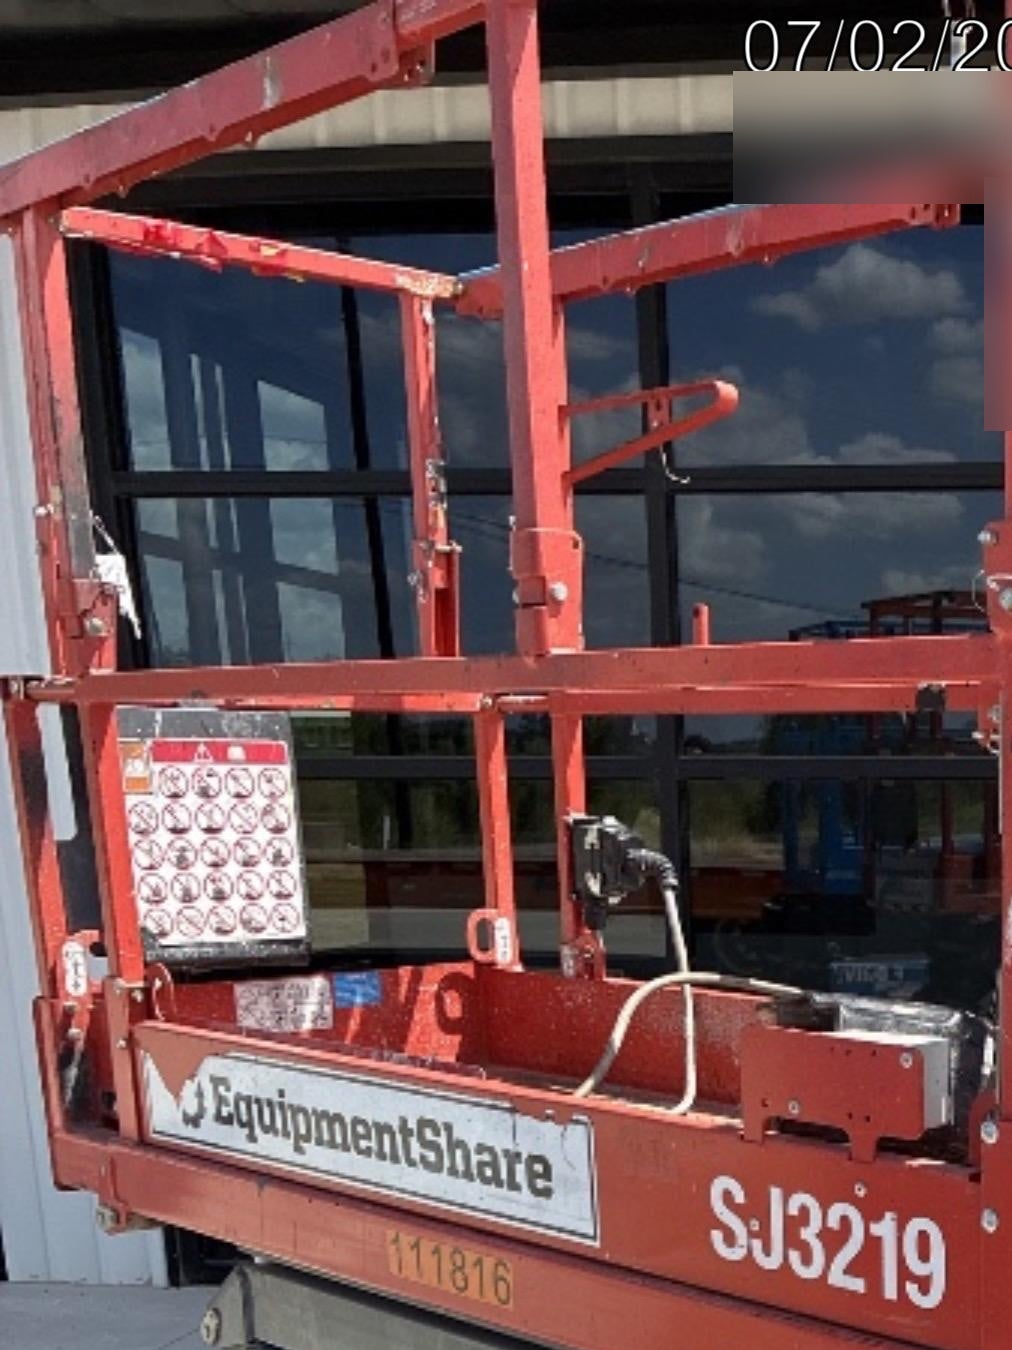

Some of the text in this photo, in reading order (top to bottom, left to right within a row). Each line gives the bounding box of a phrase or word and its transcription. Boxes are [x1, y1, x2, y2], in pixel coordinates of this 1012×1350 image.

[208, 1075, 555, 1200] EquipmentShare
[389, 1230, 512, 1307] 111816
[710, 1174, 946, 1310] SJ3219
